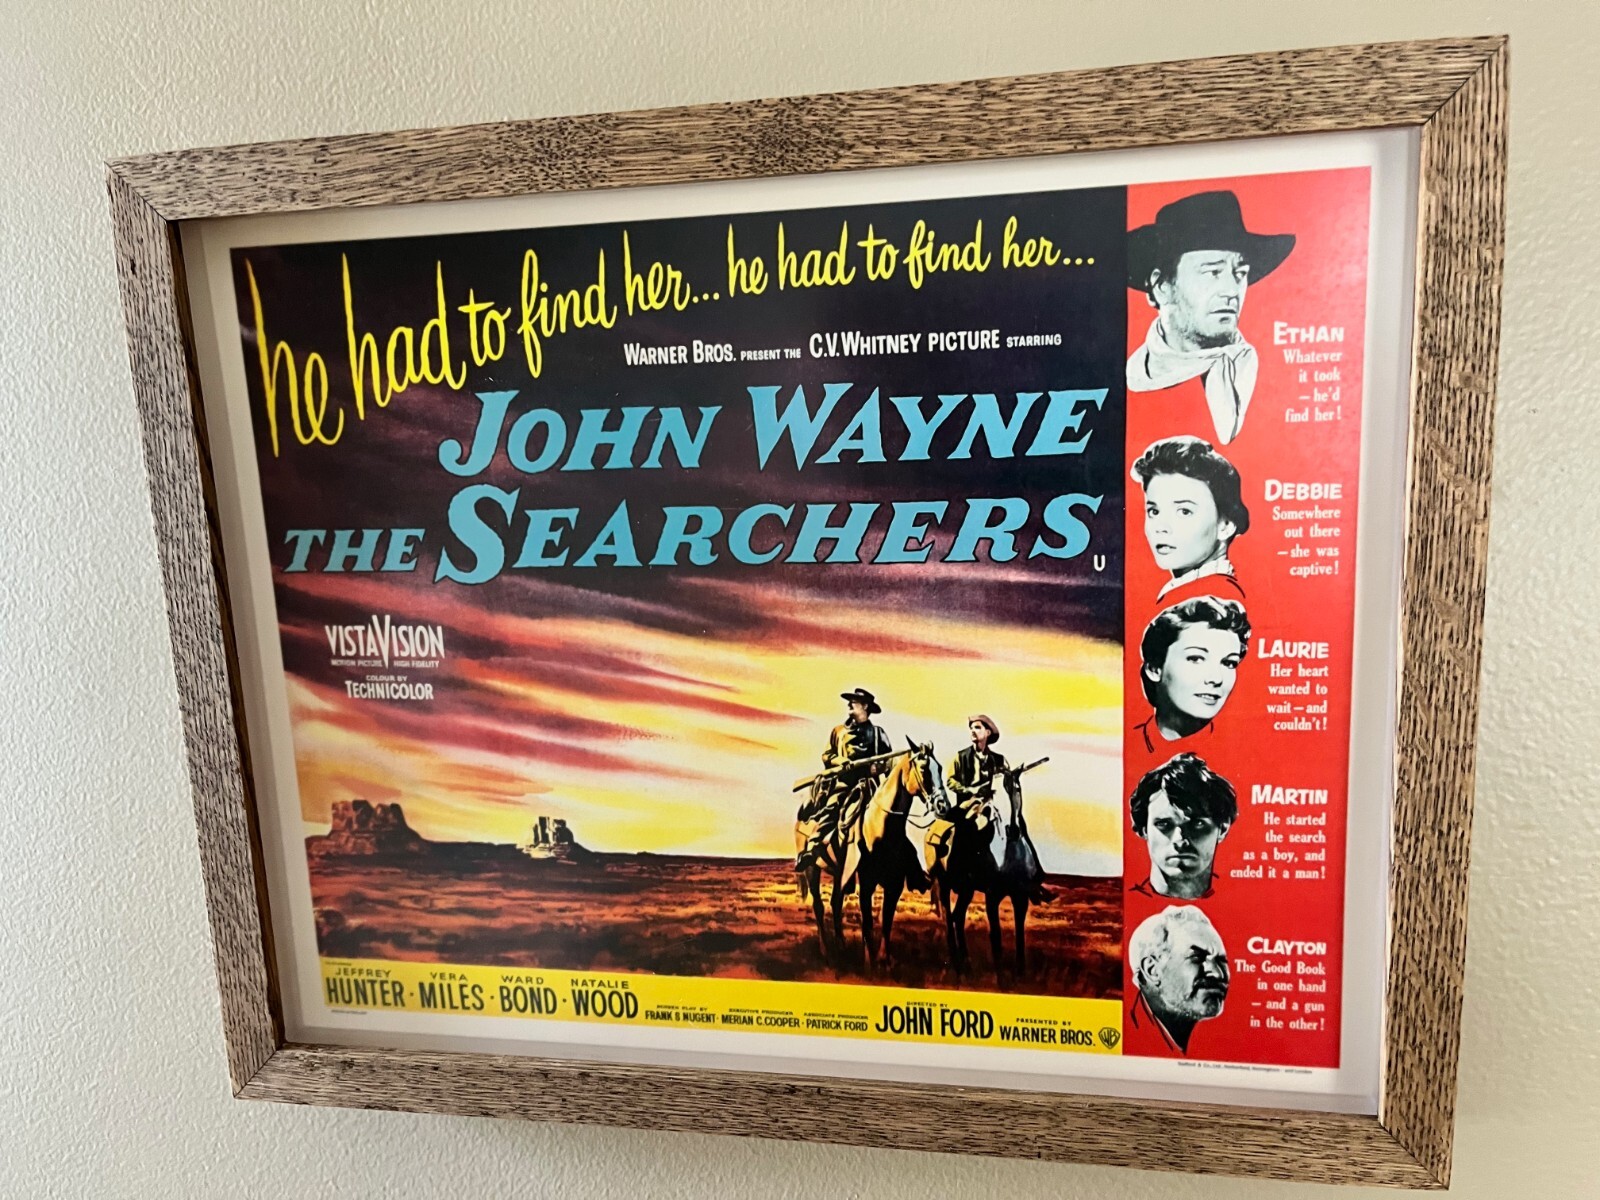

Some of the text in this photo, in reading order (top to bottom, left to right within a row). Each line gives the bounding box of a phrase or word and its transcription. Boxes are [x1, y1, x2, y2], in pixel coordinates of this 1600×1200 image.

[245, 258, 344, 457] he
[342, 252, 466, 420] had
[457, 287, 511, 367] to
[517, 248, 618, 378] find
[727, 223, 768, 298] he
[778, 220, 855, 290] had
[858, 223, 900, 280] to
[903, 219, 991, 289] find
[1273, 320, 1344, 346] ETHAN
[623, 342, 688, 366] WARNER
[692, 339, 737, 364] BROS.
[740, 349, 781, 361] PRESENT
[784, 348, 801, 359] THE
[928, 329, 1000, 352] PICTURE
[1006, 334, 1062, 348] STARRING
[1283, 348, 1342, 364] Whatever
[1298, 366, 1341, 383] it took
[1285, 407, 1309, 423] find
[438, 382, 1109, 477] JOHN WAYNE
[1264, 479, 1342, 502] DEBBIE
[1272, 504, 1341, 521] Somewhere
[283, 484, 1104, 584] THE SEARCHERS
[1284, 523, 1340, 538] out there
[1316, 547, 1339, 557] was
[1093, 554, 1106, 572] U
[1289, 560, 1339, 578] captive!
[324, 614, 445, 669] VISTAVISION
[1258, 638, 1329, 659] LAURIE
[1270, 663, 1329, 677] Her heart
[345, 680, 434, 700] TECHNICOLOR
[1268, 681, 1328, 695] wanted to
[1251, 784, 1328, 805] MARTIN
[1264, 811, 1326, 826] He started
[1265, 829, 1326, 843] the search
[1243, 851, 1255, 860] as
[1261, 851, 1268, 861] a
[1304, 848, 1326, 861] and
[1230, 864, 1263, 878] ended
[1268, 866, 1276, 879] it
[1282, 869, 1290, 879] a
[1247, 936, 1327, 956] CLAYTON
[1234, 959, 1326, 975] The Good Book
[336, 967, 629, 989] JEFFREY VERA WARD NATALIE
[1257, 977, 1326, 993] in one hand
[326, 977, 639, 1019] HUNTER MILES BOND WOOD
[1292, 1002, 1299, 1011] a
[1304, 1002, 1325, 1014] gun
[645, 1010, 672, 1022] FRANK
[682, 1012, 716, 1024] NUGENT
[721, 1013, 754, 1025] MERIAN
[806, 1018, 868, 1032] PATRICK FORD
[875, 1005, 994, 1039] JOHN FORD
[1016, 1017, 1058, 1026] PRESENTED
[1250, 1015, 1260, 1028] in
[1266, 1016, 1284, 1028] the
[999, 1024, 1096, 1047] WARNER BROS.
